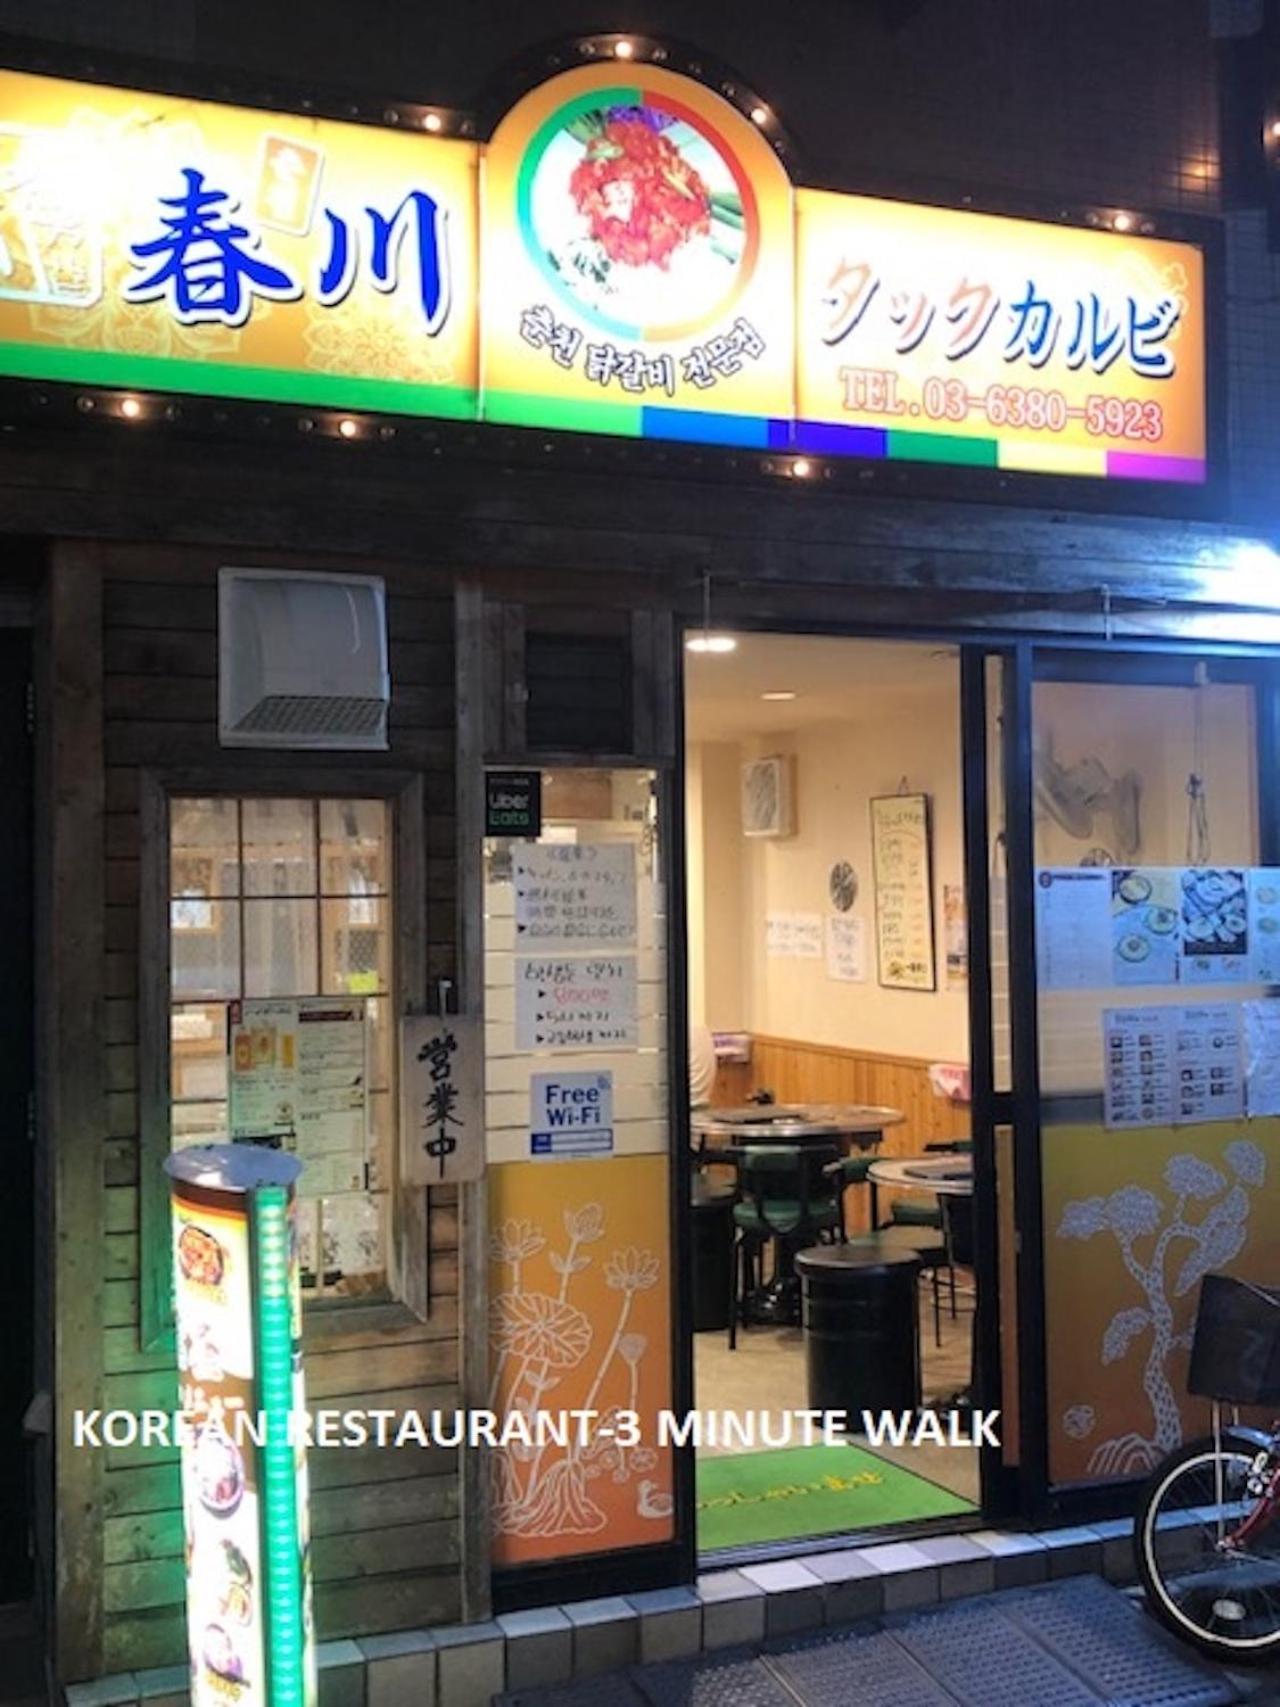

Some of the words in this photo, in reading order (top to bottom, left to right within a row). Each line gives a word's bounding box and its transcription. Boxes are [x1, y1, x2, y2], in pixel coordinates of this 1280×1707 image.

[124, 167, 446, 332] 春川
[519, 305, 584, 369] 춘천
[584, 343, 676, 398] 닭갈비
[680, 316, 767, 390] 전문점
[822, 256, 1180, 378] タックカルビ
[416, 1028, 465, 1180] 営業中
[545, 1083, 600, 1105] Free
[545, 1106, 601, 1127] Wi-Fi
